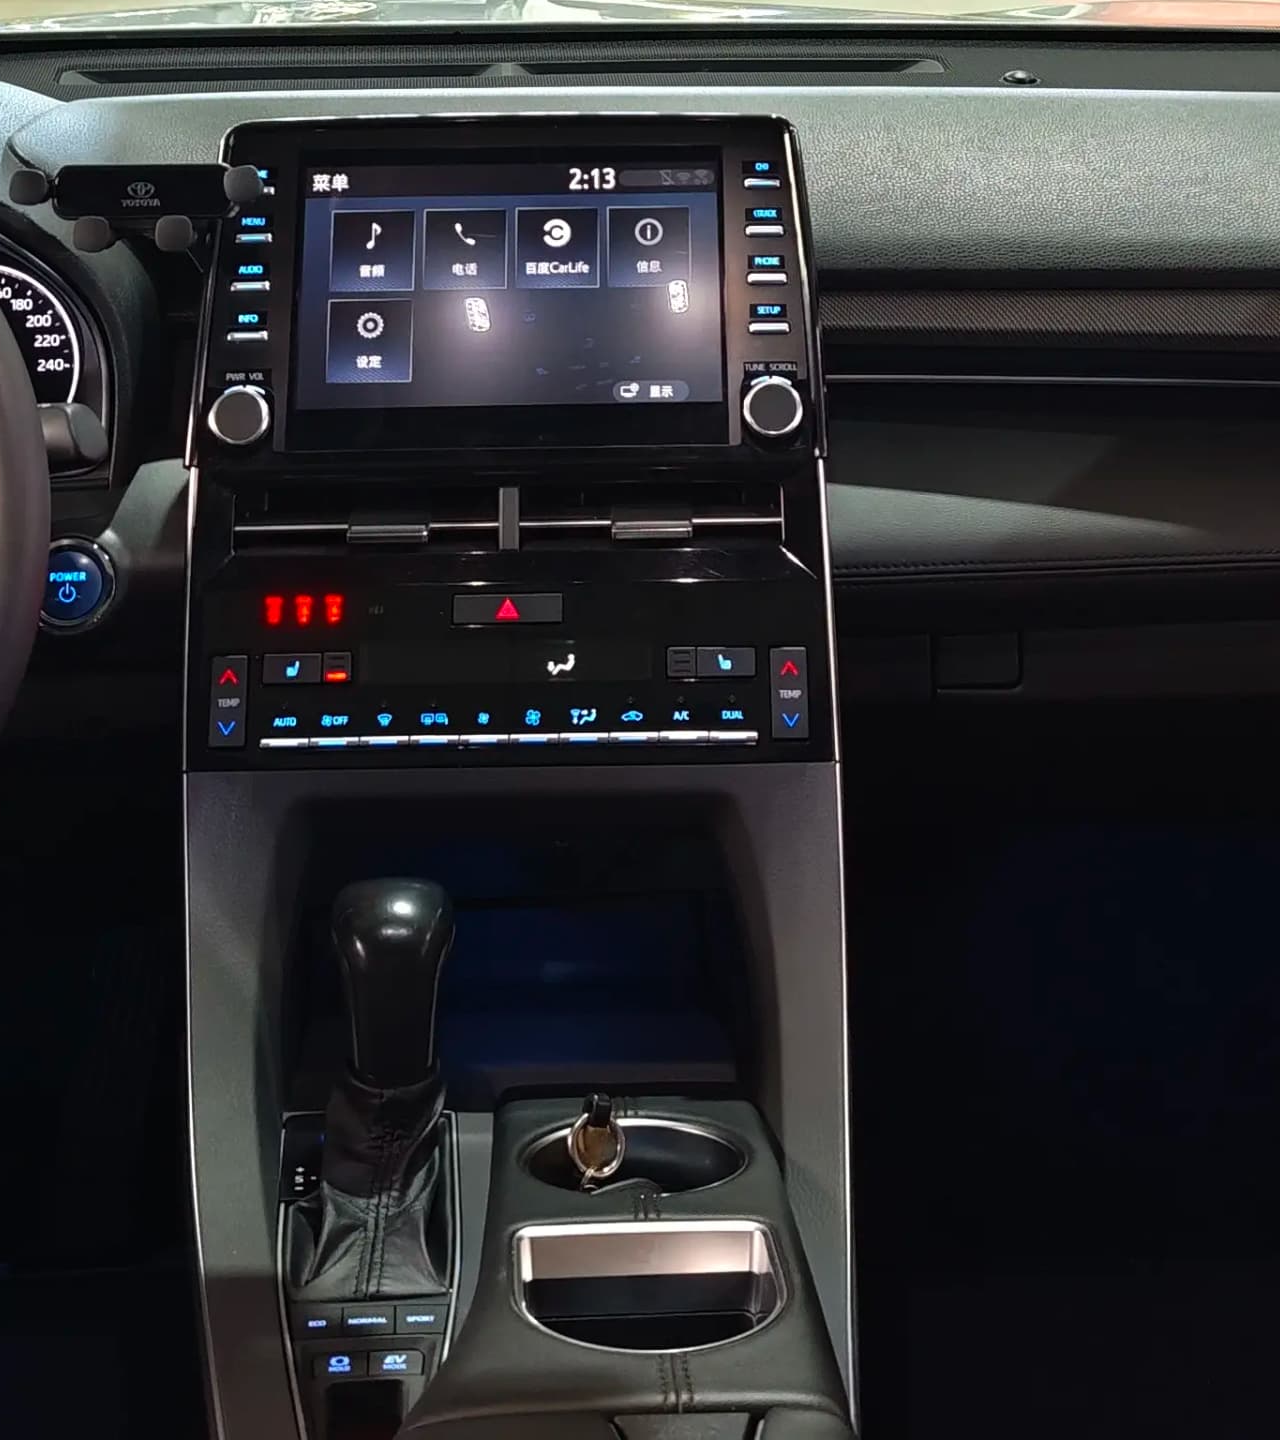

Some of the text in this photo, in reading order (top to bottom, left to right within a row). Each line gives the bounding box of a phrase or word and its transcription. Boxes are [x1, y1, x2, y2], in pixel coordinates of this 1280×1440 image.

[312, 172, 350, 193] 菜单
[568, 167, 617, 191] 2:13
[121, 198, 161, 208] TOYOTA
[241, 216, 266, 227] MENU
[754, 256, 780, 266] PHONE
[238, 265, 264, 275] AUDIO
[359, 263, 385, 278] 音频
[451, 261, 478, 277] 电话
[524, 261, 591, 276] 百度CarLife
[636, 260, 663, 275] 信息
[9, 298, 34, 311] 180
[756, 305, 782, 315] SETUP
[25, 314, 53, 328] 200
[237, 314, 259, 324] INFO
[33, 333, 61, 348] 220
[37, 358, 65, 372] 240
[355, 354, 383, 370] 设定
[649, 384, 674, 399] 显示
[49, 571, 87, 583] POWER
[778, 689, 803, 699] TEMP
[217, 698, 241, 708] TEMP
[332, 715, 349, 726] OFF
[672, 710, 690, 721] A/C
[721, 710, 745, 720] DUAL
[273, 716, 297, 728] AUTO
[307, 1319, 327, 1328] ECO
[383, 1354, 408, 1364] EV
